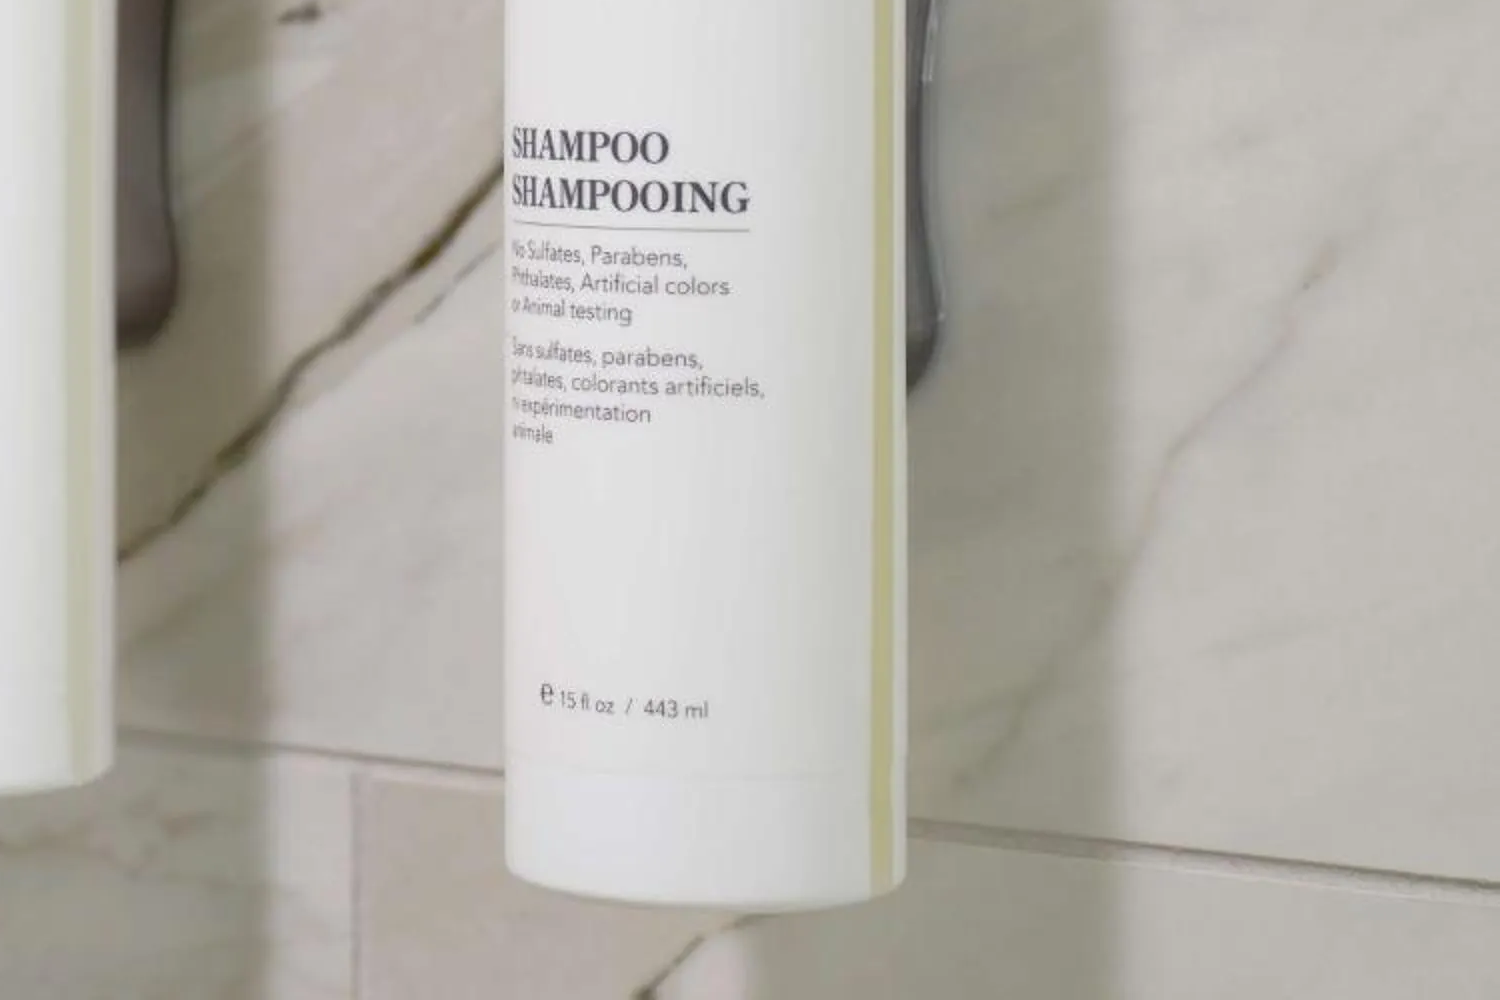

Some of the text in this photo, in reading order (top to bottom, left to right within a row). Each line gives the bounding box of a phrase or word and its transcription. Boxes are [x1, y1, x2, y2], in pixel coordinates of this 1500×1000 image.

[512, 127, 670, 164] SHAMPOO
[512, 175, 751, 214] SHAMPOOING
[591, 244, 689, 269] Parabens,
[580, 272, 658, 295] Artificial
[665, 275, 731, 296] colors
[569, 302, 633, 327] testing
[602, 346, 704, 371] parabens,
[571, 369, 659, 396] colorants
[665, 376, 765, 399] artificiels,
[560, 689, 577, 709] 15
[595, 698, 615, 714] oz
[643, 698, 679, 719] 443
[684, 699, 710, 719] ml
